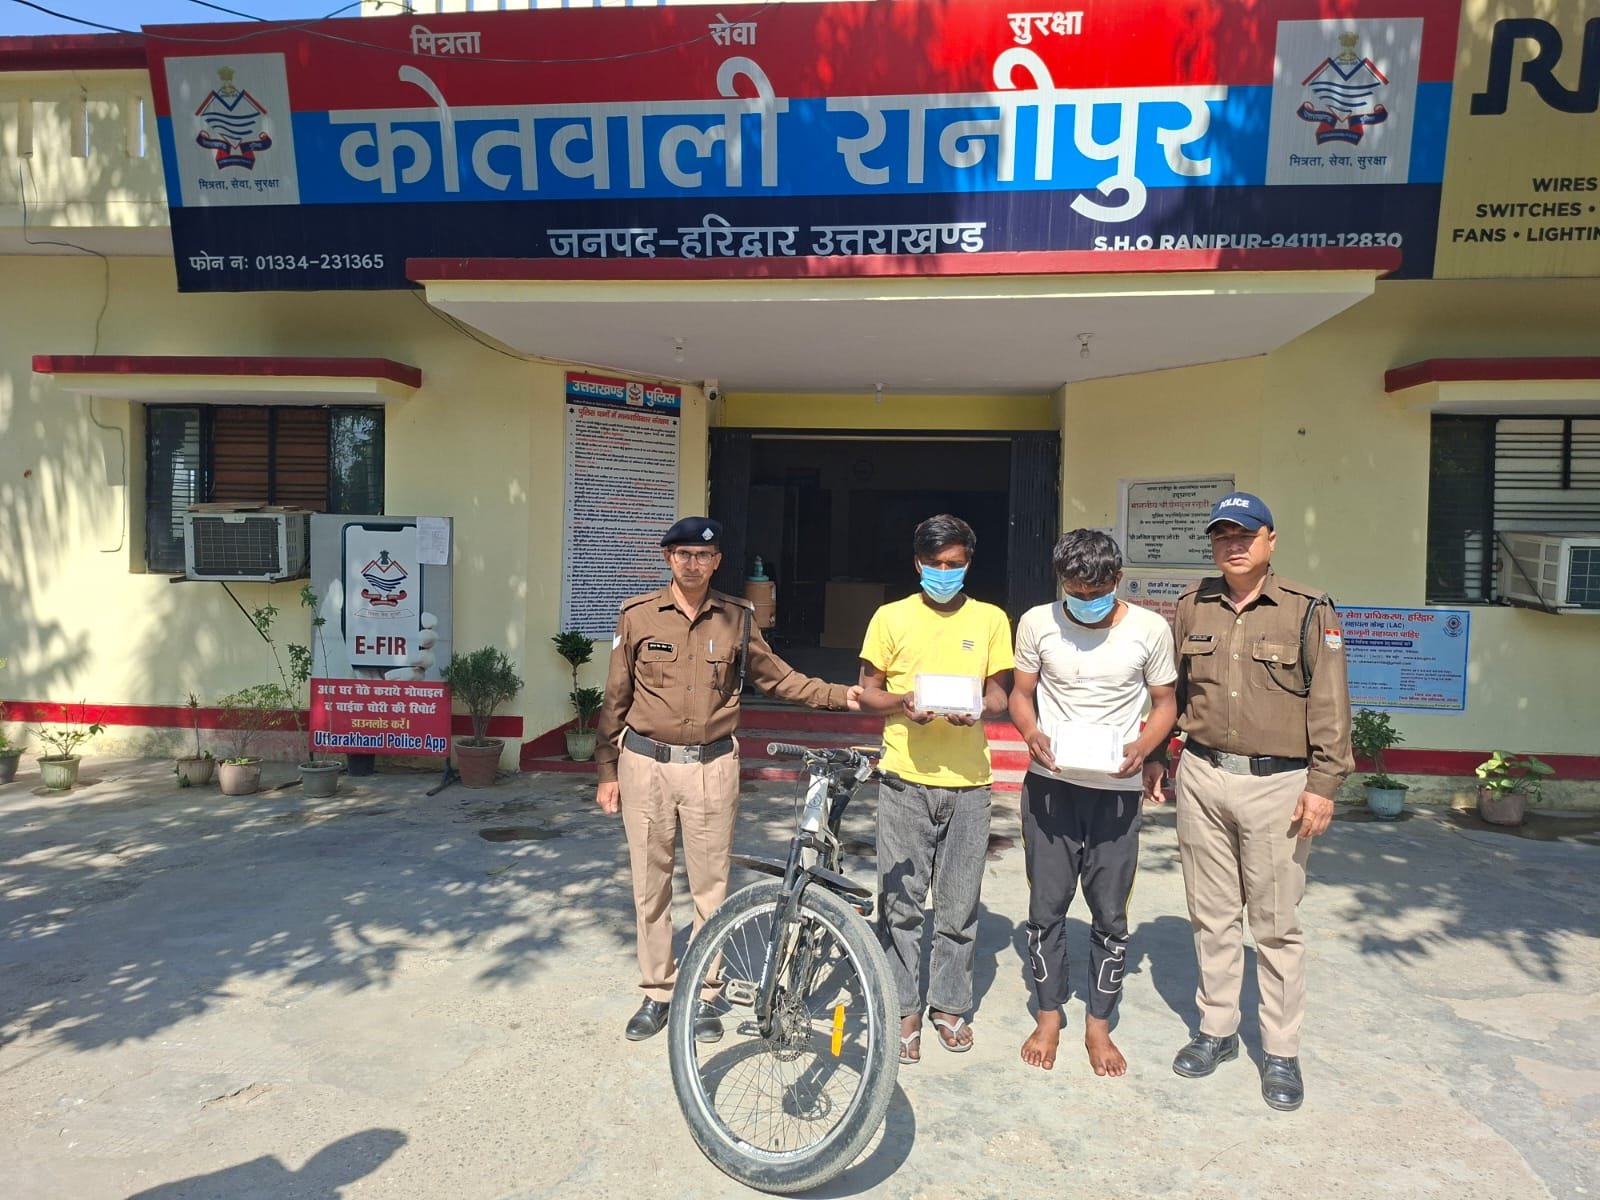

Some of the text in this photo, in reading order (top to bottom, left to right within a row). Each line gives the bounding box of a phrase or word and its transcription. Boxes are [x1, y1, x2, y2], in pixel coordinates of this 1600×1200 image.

[708, 13, 757, 46] सेवा
[1007, 10, 1084, 43] सुरक्षा
[410, 25, 481, 54] मित्रता
[328, 47, 1228, 222] कोतवाली रानीपुर
[1357, 154, 1387, 169] सुरक्षा
[255, 178, 280, 192] सुरक्षा
[1532, 177, 1598, 192] WIRES
[1475, 203, 1582, 218] SWITCHES
[811, 221, 987, 256] उत्तराखण्ड
[1160, 231, 1402, 250] RANIPUR-94111-12830
[1452, 228, 1506, 243] FANS
[189, 250, 224, 272] फोन
[255, 253, 384, 271] 01334-231365
[571, 380, 625, 399] उत्तराखण्ड
[645, 387, 675, 407] पुलिस
[1219, 497, 1250, 510] POLICE
[355, 635, 406, 655] E-FIR
[338, 685, 352, 695] घर
[391, 701, 406, 714] की
[351, 717, 389, 729] डाउनलोड
[314, 730, 446, 751] Uttarakhand Police App
